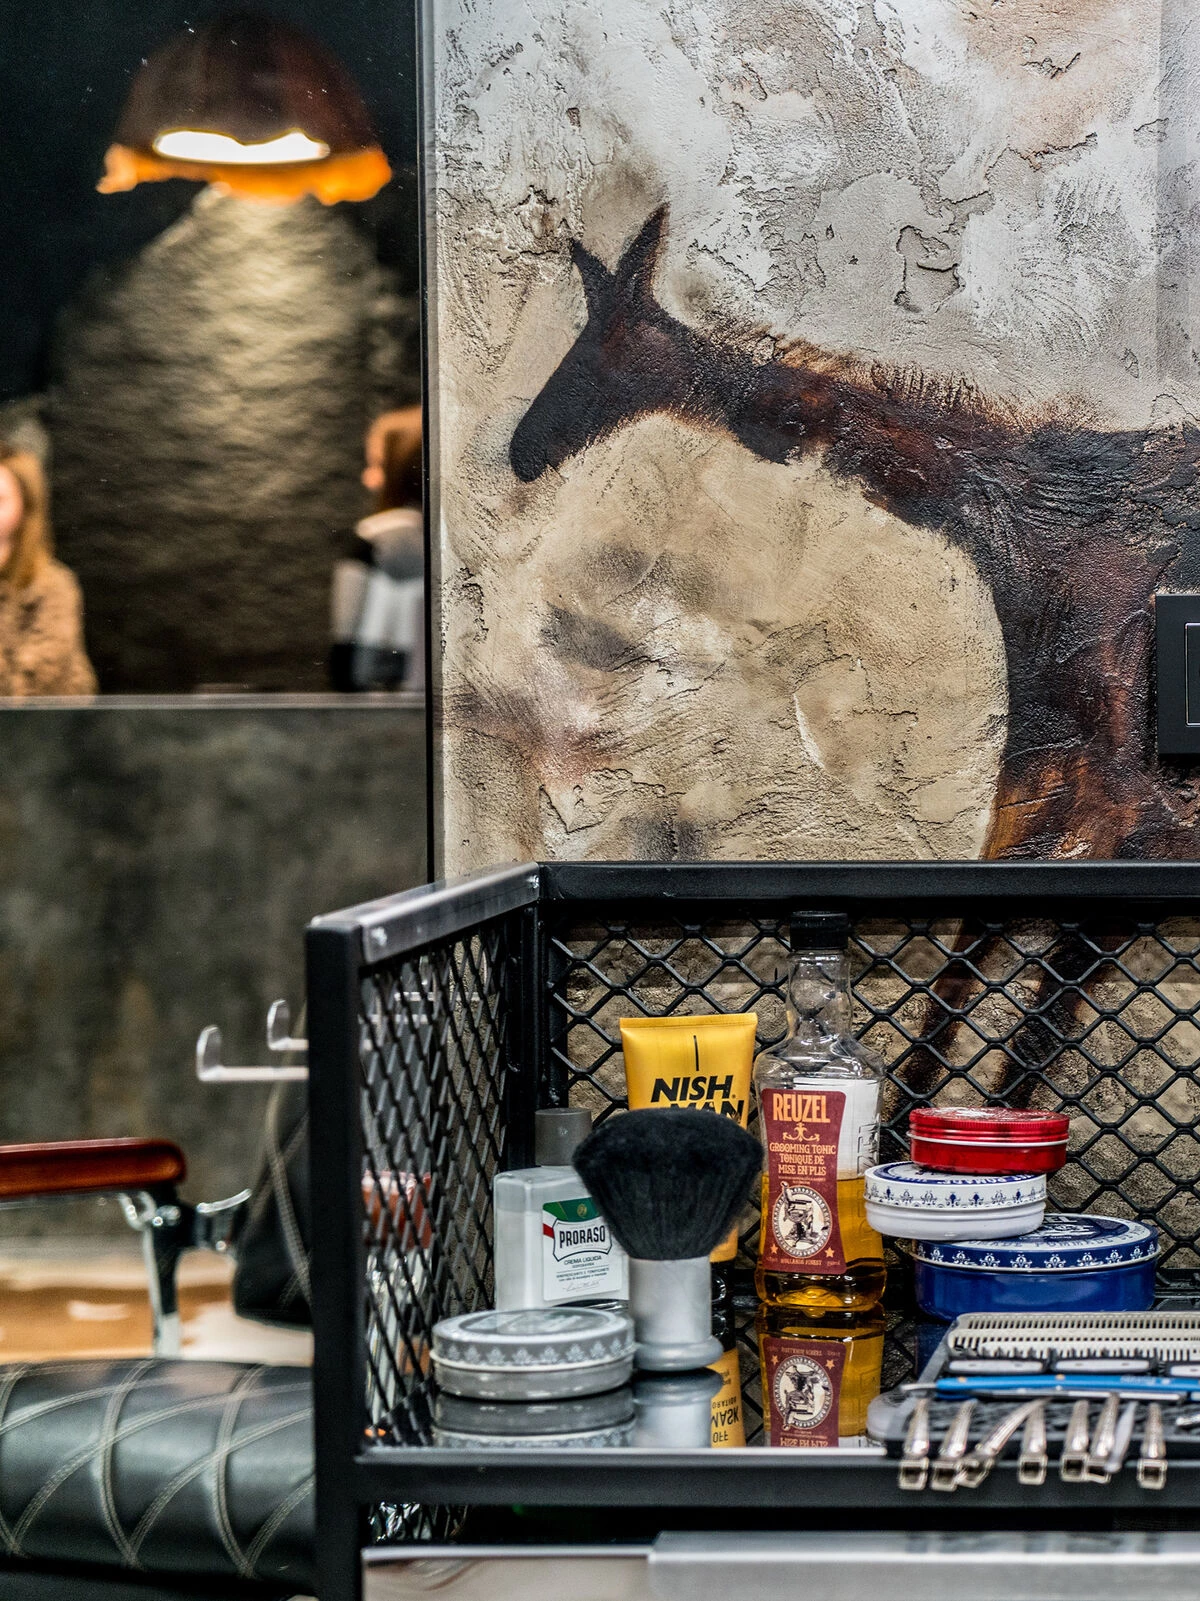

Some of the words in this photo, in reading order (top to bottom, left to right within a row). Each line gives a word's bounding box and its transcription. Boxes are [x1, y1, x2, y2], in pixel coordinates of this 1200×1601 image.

[651, 1075, 734, 1102] NISH
[773, 1093, 830, 1123] REUZEL
[770, 1143, 810, 1154] GROOMING
[811, 1145, 836, 1154] TONIC
[779, 1153, 813, 1165] TONIQUE
[814, 1155, 825, 1165] DE
[778, 1164, 796, 1174] MISE
[797, 1165, 808, 1175] EN
[809, 1166, 826, 1176] PLIS
[559, 1225, 606, 1248] PRORASO
